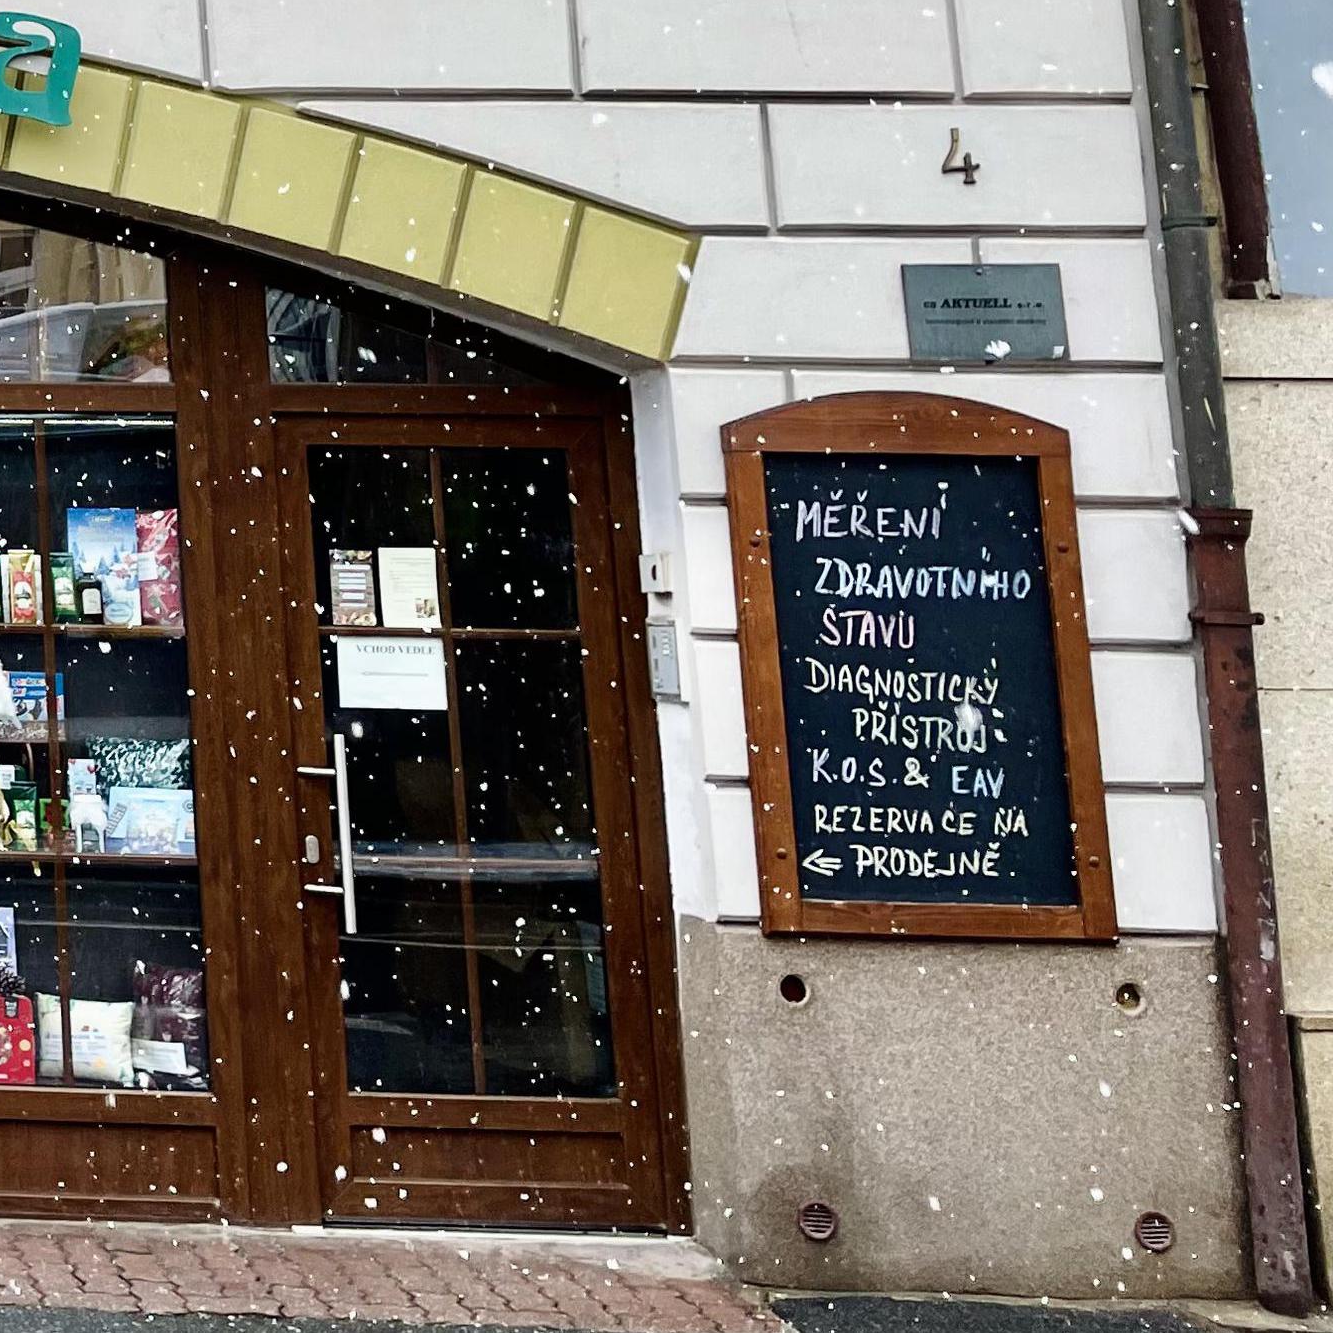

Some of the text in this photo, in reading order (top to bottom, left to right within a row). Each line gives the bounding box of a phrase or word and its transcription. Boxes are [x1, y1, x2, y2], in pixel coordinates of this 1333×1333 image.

[941, 127, 981, 185] 4
[940, 298, 1012, 309] AKTUELL
[795, 488, 947, 543] MĚŘENÍ
[814, 546, 1032, 601] ZDRAVOTNÍHO
[356, 644, 437, 656] VCHOD VEDLE
[803, 656, 999, 705] DIAGNOSTICKÝ
[851, 700, 987, 754] PŘÍSTROJ
[812, 747, 1005, 799] K.O.S. & EAV
[814, 803, 1030, 838] REZERVACE NA
